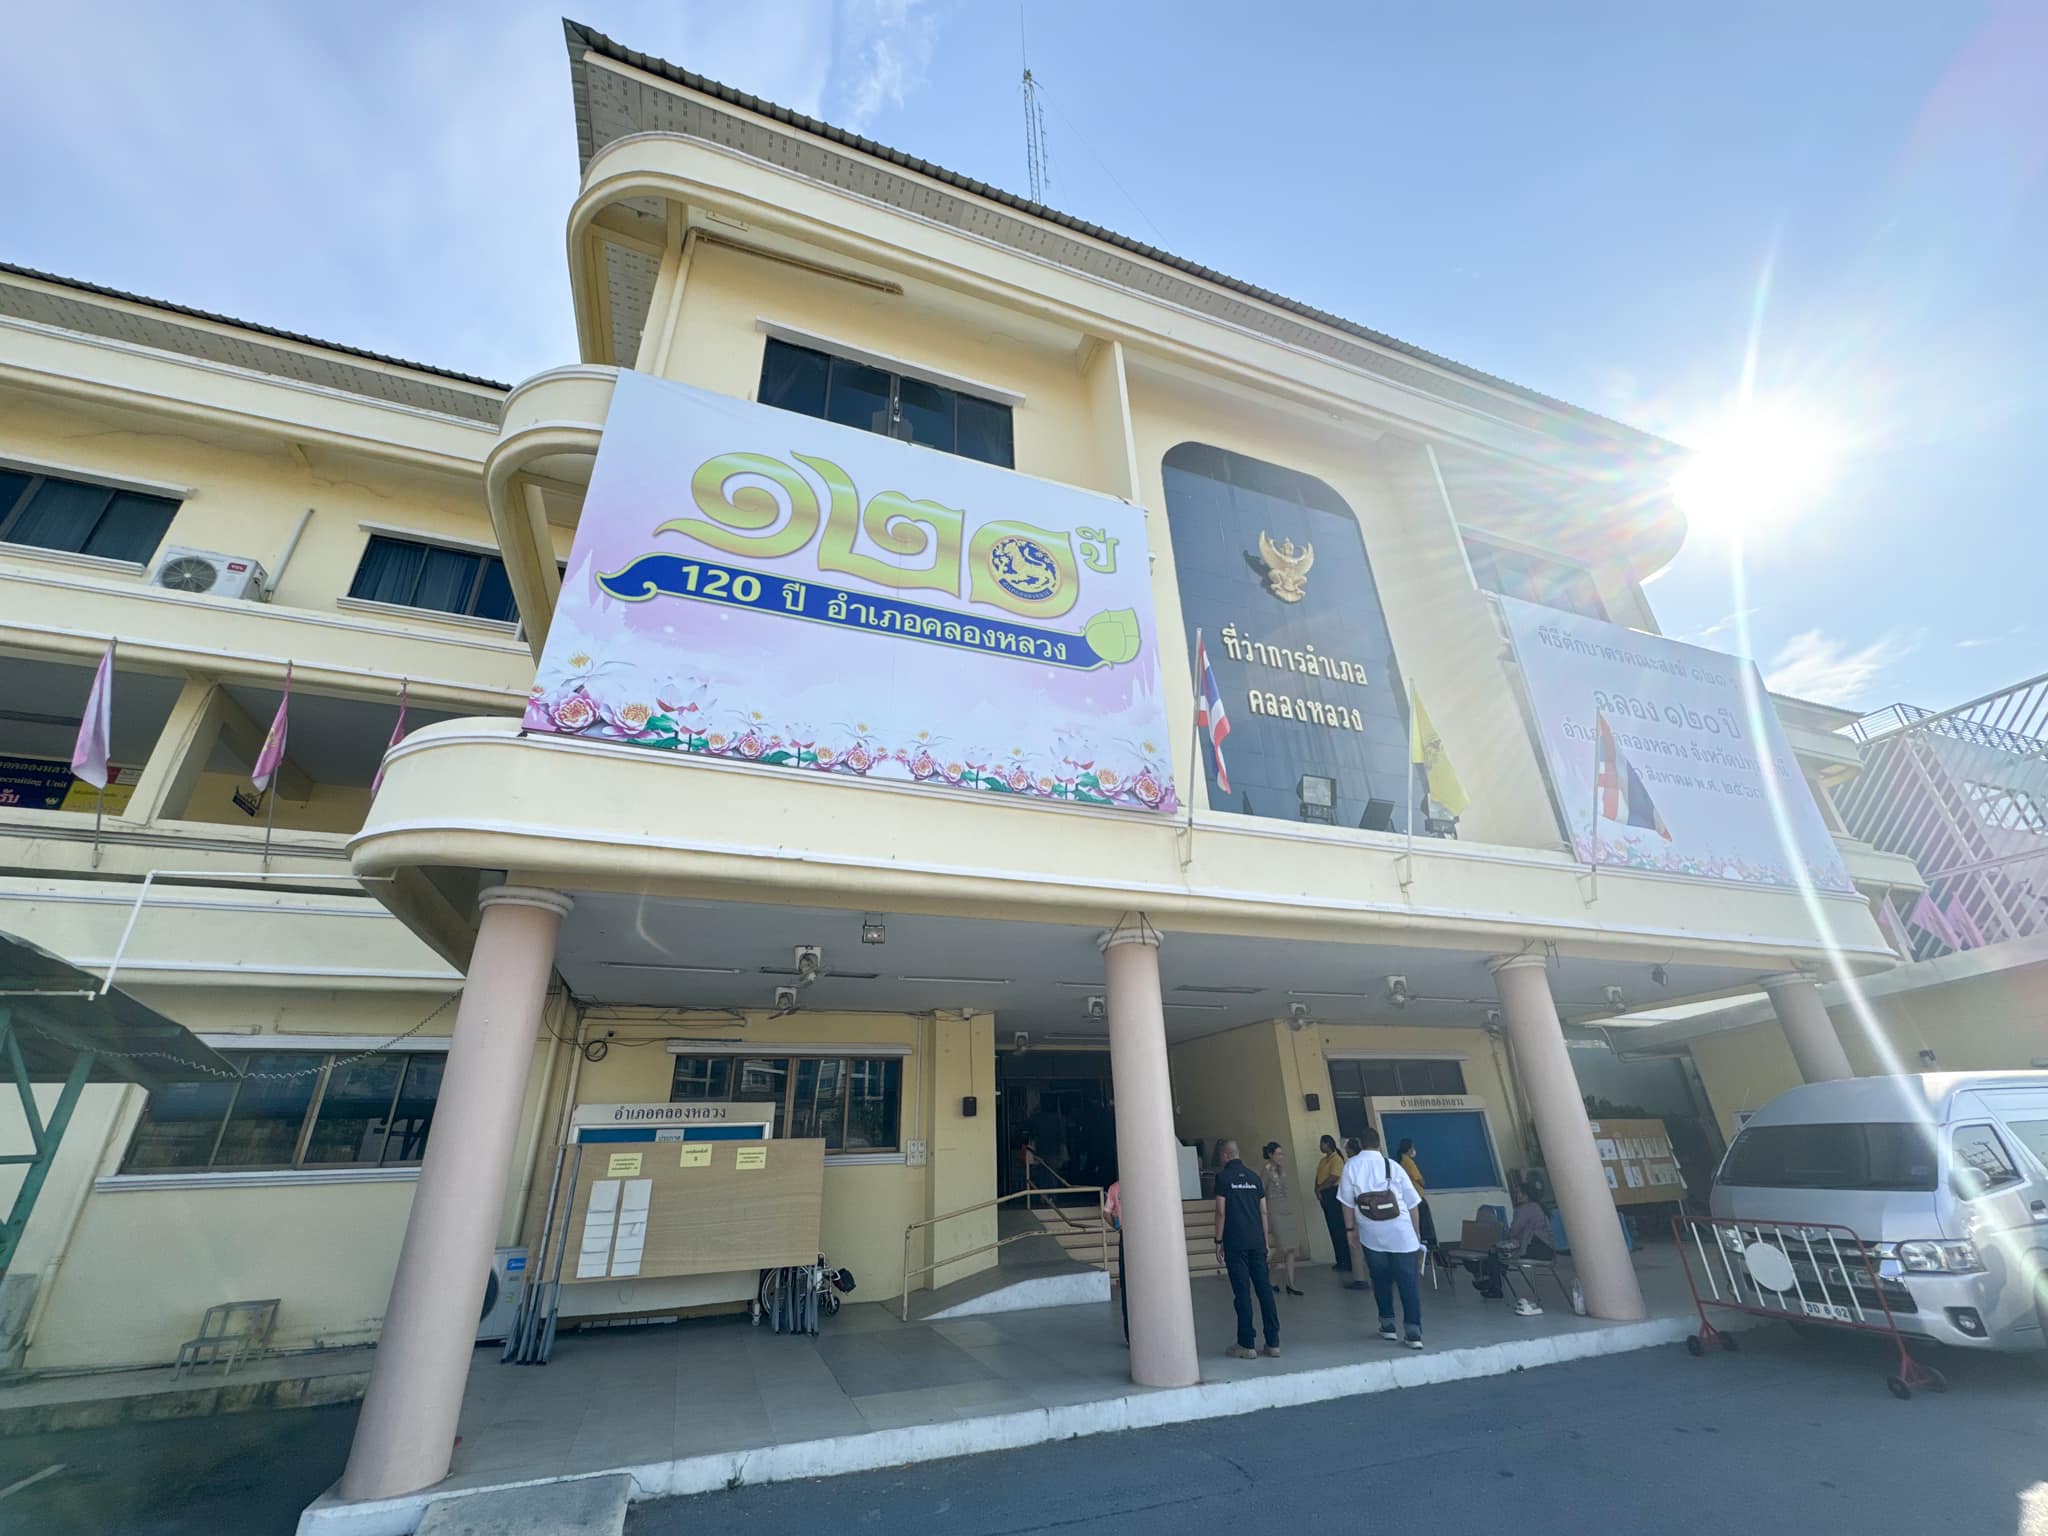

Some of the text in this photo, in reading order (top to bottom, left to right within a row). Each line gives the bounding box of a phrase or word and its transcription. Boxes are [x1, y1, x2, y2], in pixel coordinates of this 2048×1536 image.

[653, 450, 1119, 619] ๑๒๐ ปี
[680, 565, 1067, 661] 120 ปี อำเภอคลองหลวง
[1221, 622, 1369, 685] ที่ว่าการอำเภอ
[1249, 690, 1364, 732] คลองหลวง
[1593, 690, 1660, 722] ฉลอง
[614, 1105, 727, 1121] อำเภอคลองหลวง
